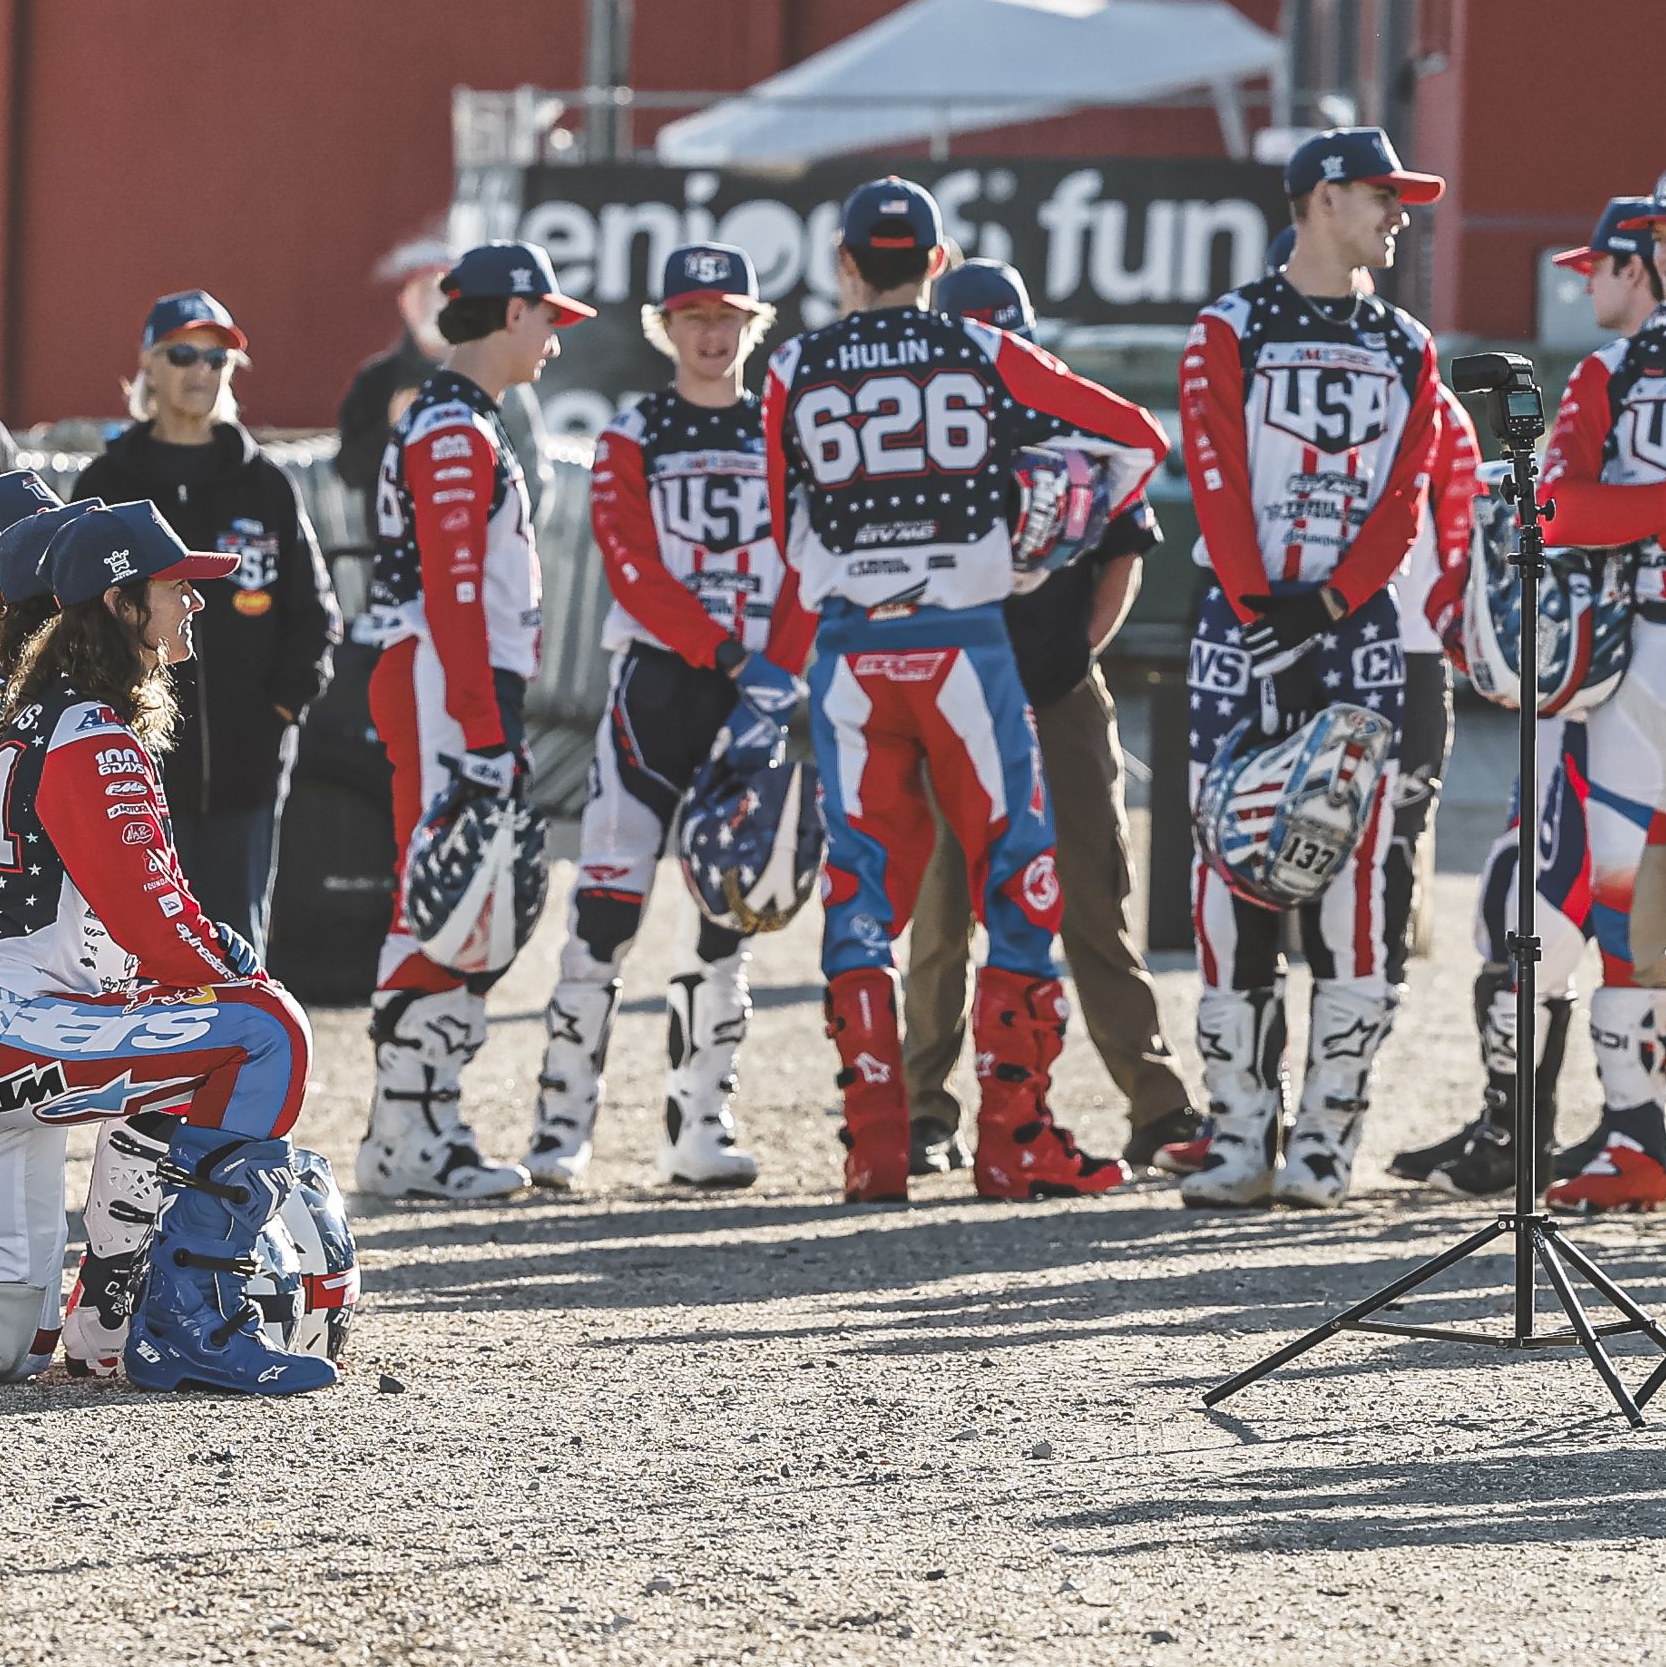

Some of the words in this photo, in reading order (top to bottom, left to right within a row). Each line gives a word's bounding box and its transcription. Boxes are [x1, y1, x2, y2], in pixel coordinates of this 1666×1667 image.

[1036, 167, 1266, 306] fun
[838, 338, 930, 372] HULIN
[793, 371, 992, 486] 626
[1263, 367, 1391, 448] USA
[660, 476, 772, 546] USA
[1282, 835, 1335, 876] 137
